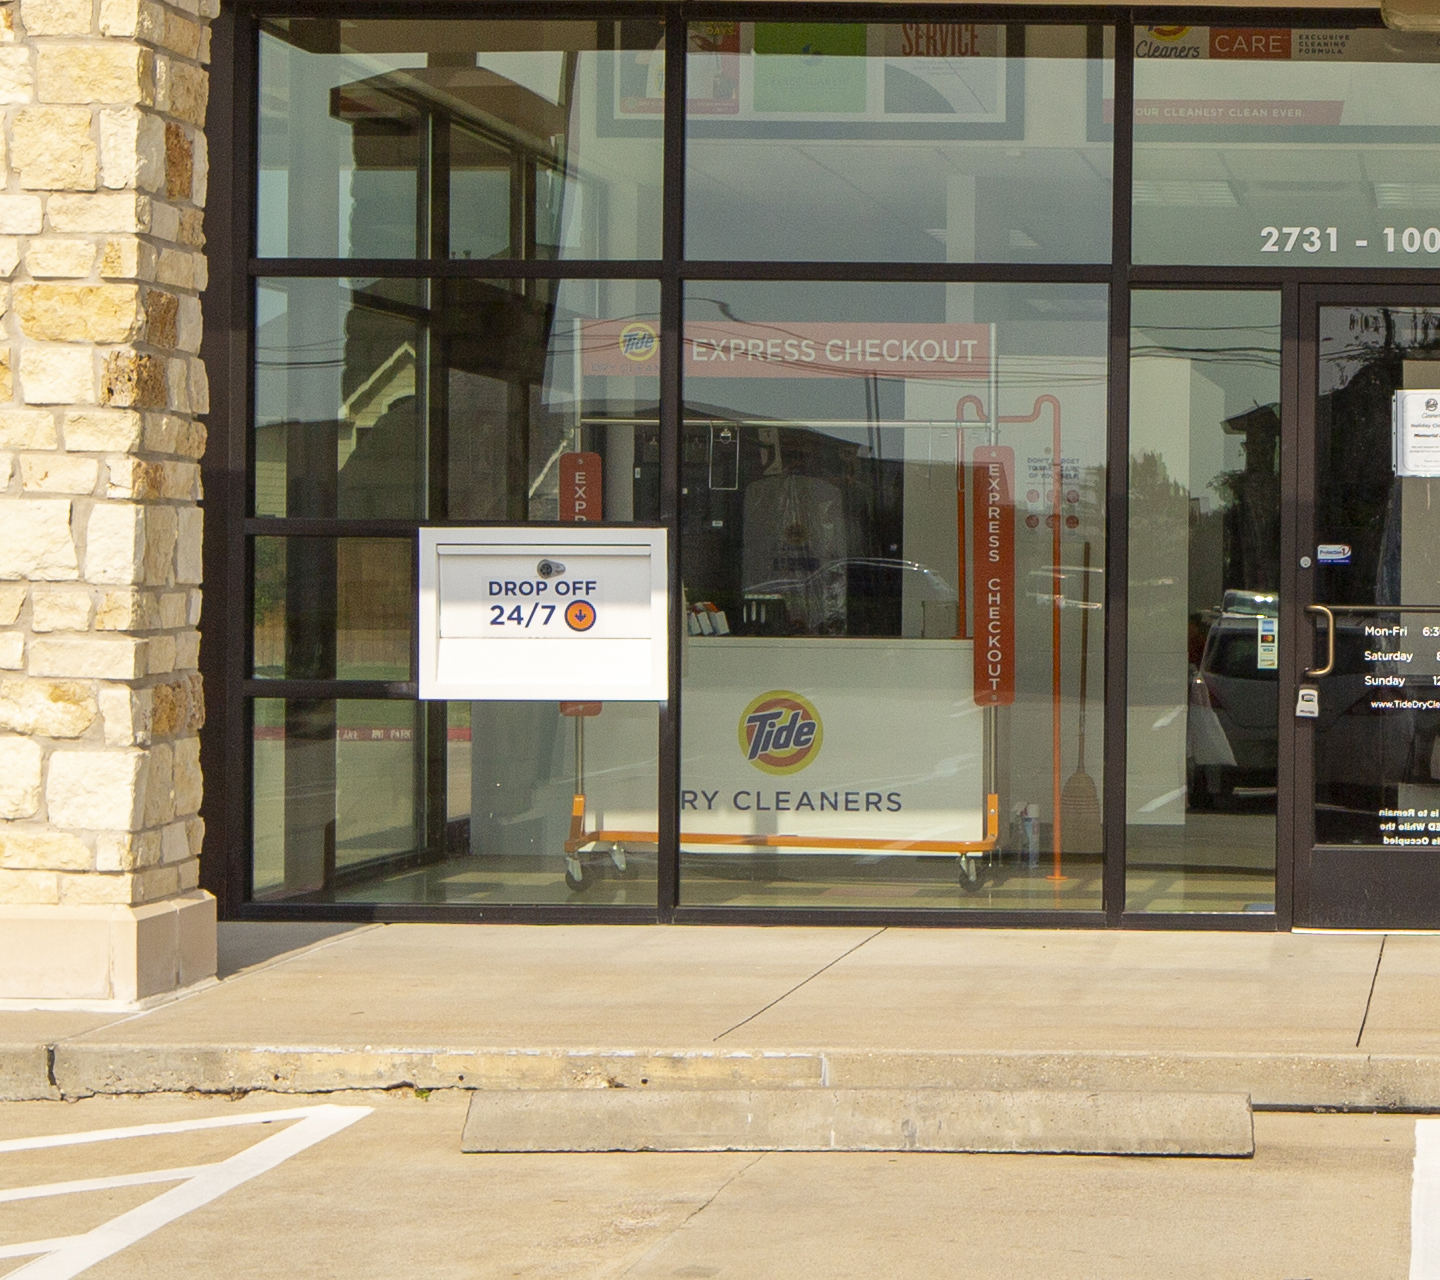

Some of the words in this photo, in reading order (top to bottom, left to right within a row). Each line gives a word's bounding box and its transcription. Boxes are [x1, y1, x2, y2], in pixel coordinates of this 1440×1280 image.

[901, 23, 981, 57] SERVICE
[1135, 39, 1201, 59] Cleaners
[1214, 34, 1283, 54] CARE
[1163, 107, 1224, 118] CLEANEST
[1229, 108, 1268, 118] CLEAN
[1260, 226, 1338, 253] 2731
[691, 339, 816, 362] EXPRESS
[825, 339, 978, 363] CHECKOUT
[988, 463, 1001, 562] EXPRESS
[488, 581, 548, 597] DROP
[554, 581, 597, 597] OFF
[489, 602, 556, 628] 24/7
[987, 578, 1002, 690] CHECKOUT
[1364, 626, 1408, 637] Mon-Fri
[1364, 651, 1414, 663] Saturday
[1364, 675, 1406, 688] Sunday
[744, 708, 817, 761] Tide
[681, 790, 719, 811] RY
[733, 790, 903, 812] CLEANERS
